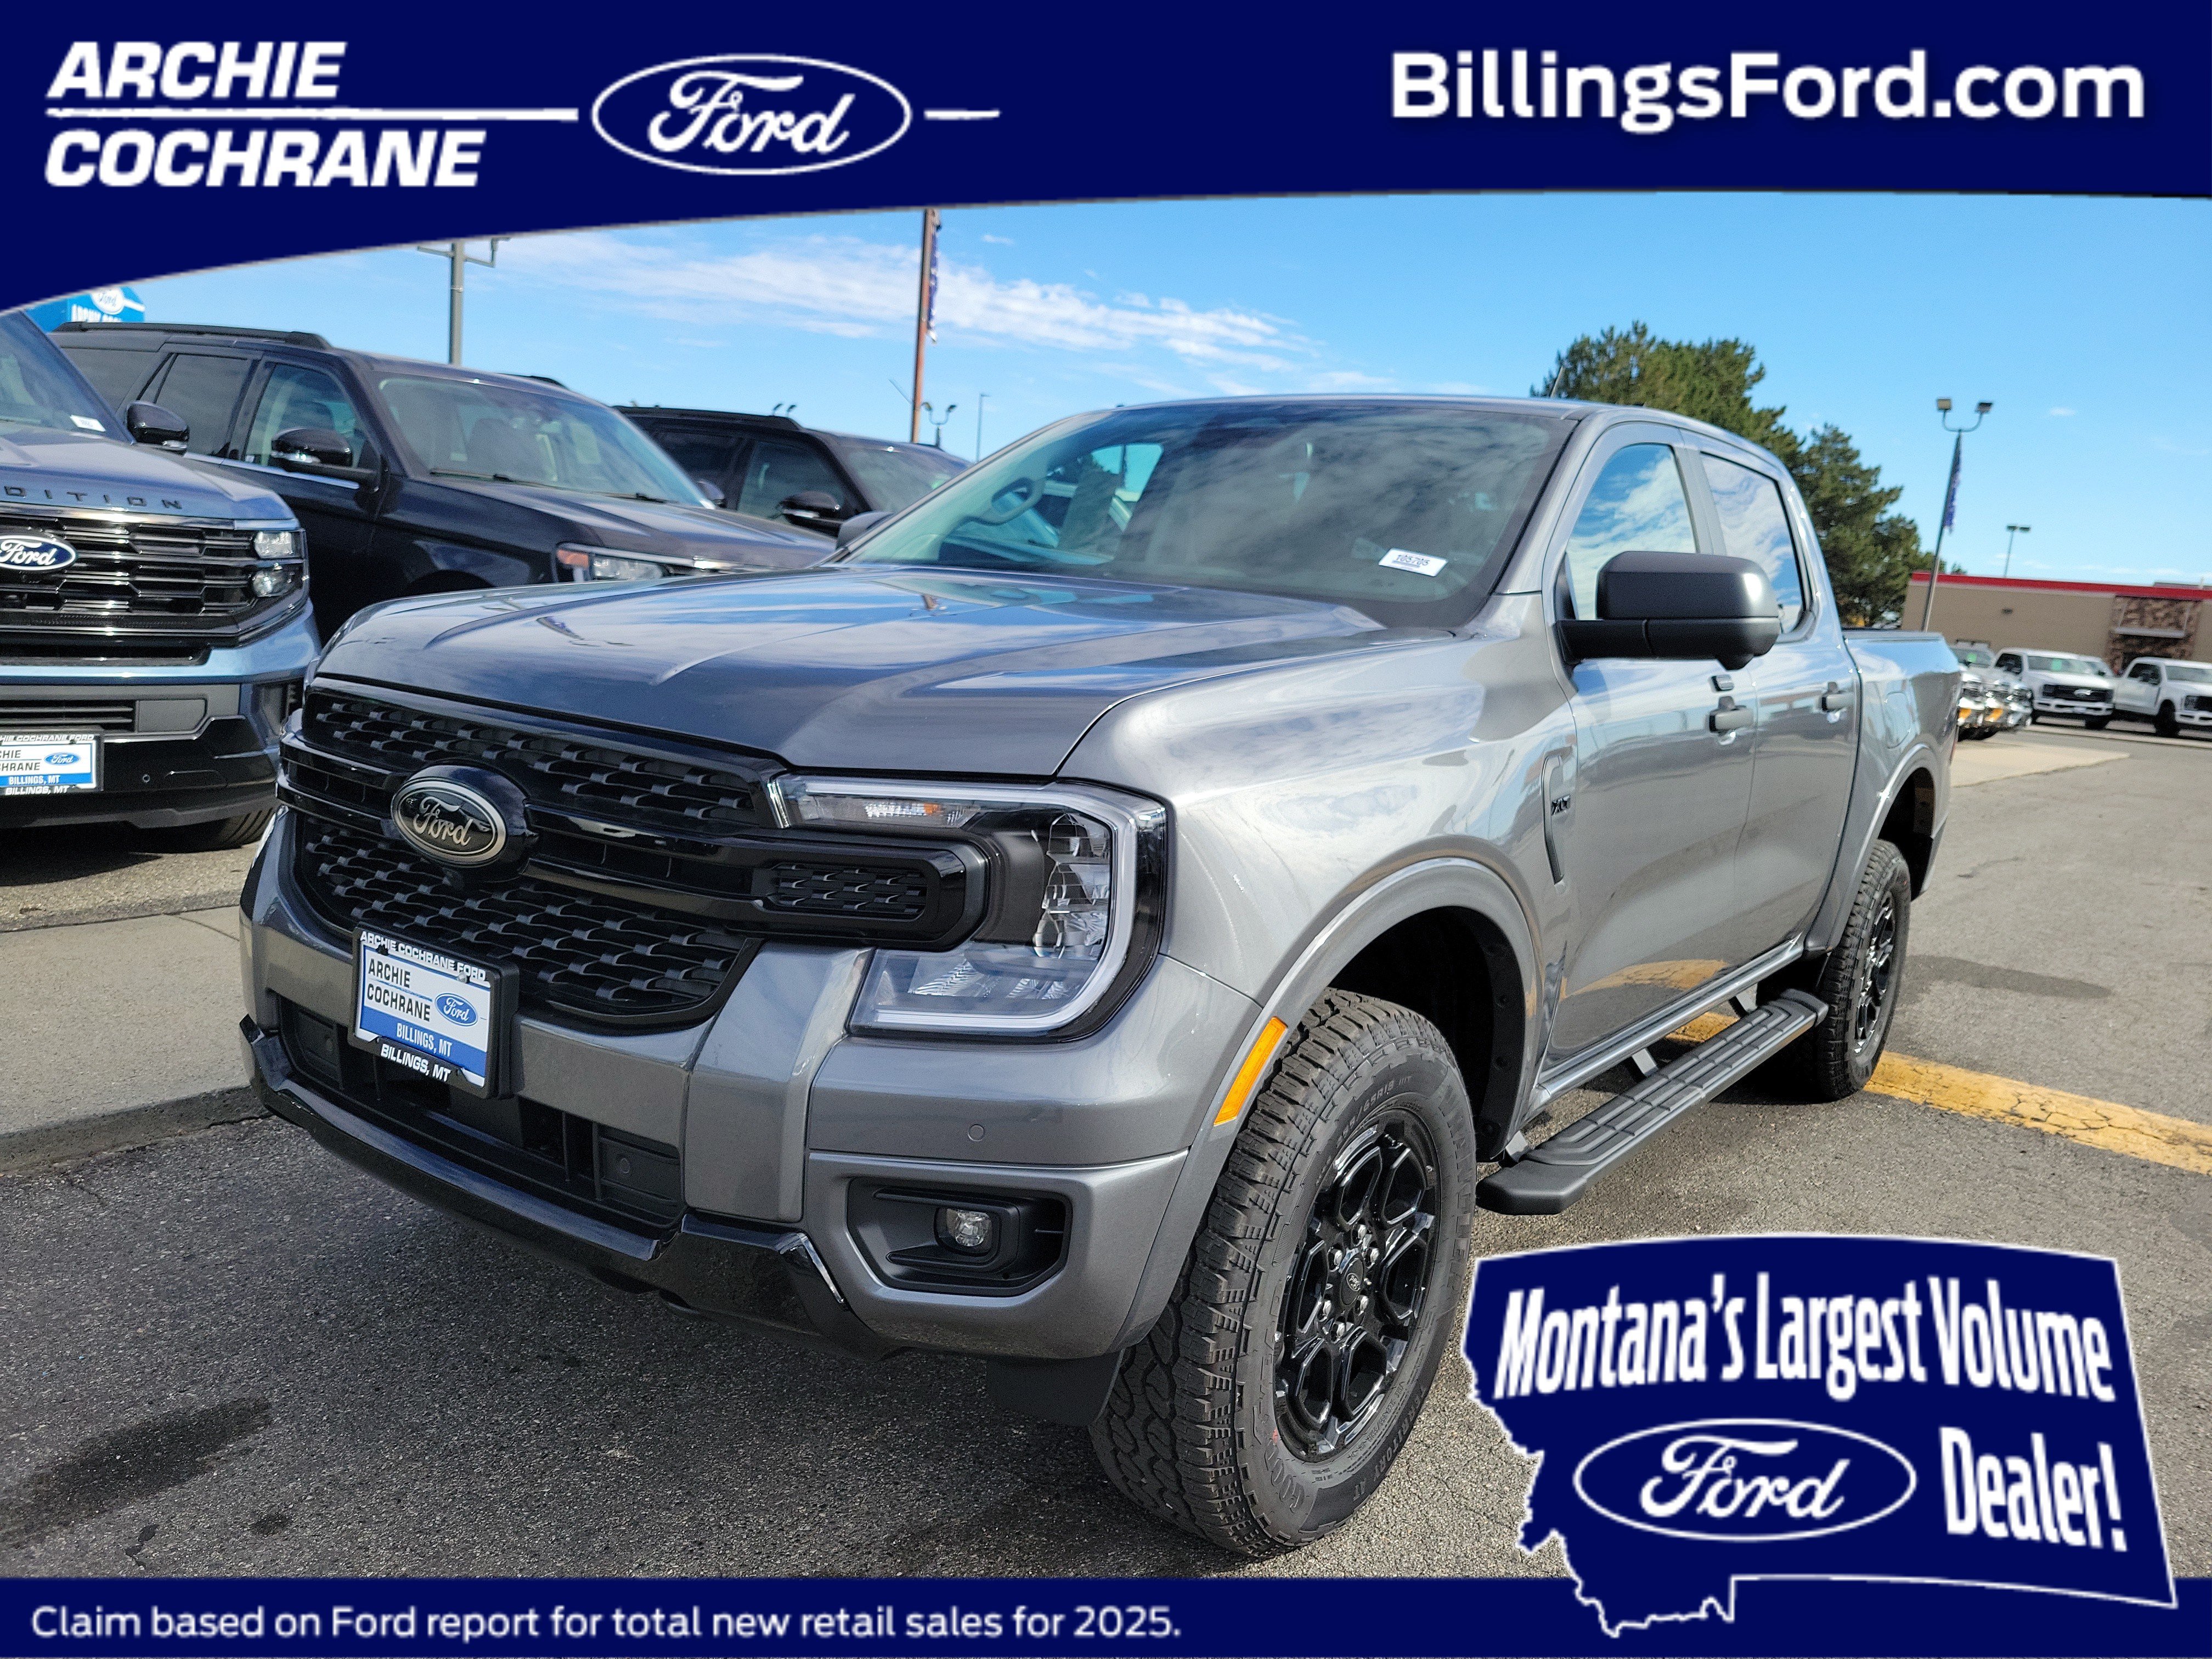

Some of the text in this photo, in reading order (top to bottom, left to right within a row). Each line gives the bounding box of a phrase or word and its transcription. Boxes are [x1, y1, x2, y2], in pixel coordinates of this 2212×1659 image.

[0, 540, 57, 566] Ford
[0, 763, 41, 771] HRANE
[51, 754, 74, 764] Ford
[5, 785, 70, 795] BILLINGS, MT
[9, 775, 60, 785] BILLINGS, MT
[413, 795, 474, 846] Ford
[360, 931, 486, 981] ARCHIE COCHRANE FORD
[368, 958, 411, 989] ARCHIE
[366, 983, 431, 1022] COCHRANE
[443, 997, 470, 1023] Ford
[396, 1023, 453, 1057] BILLINGS, MT
[381, 1043, 451, 1082] BILLINGS, MT
[1335, 1079, 1395, 1149] 255/65R18
[1373, 1384, 1427, 1481] TERRITORY
